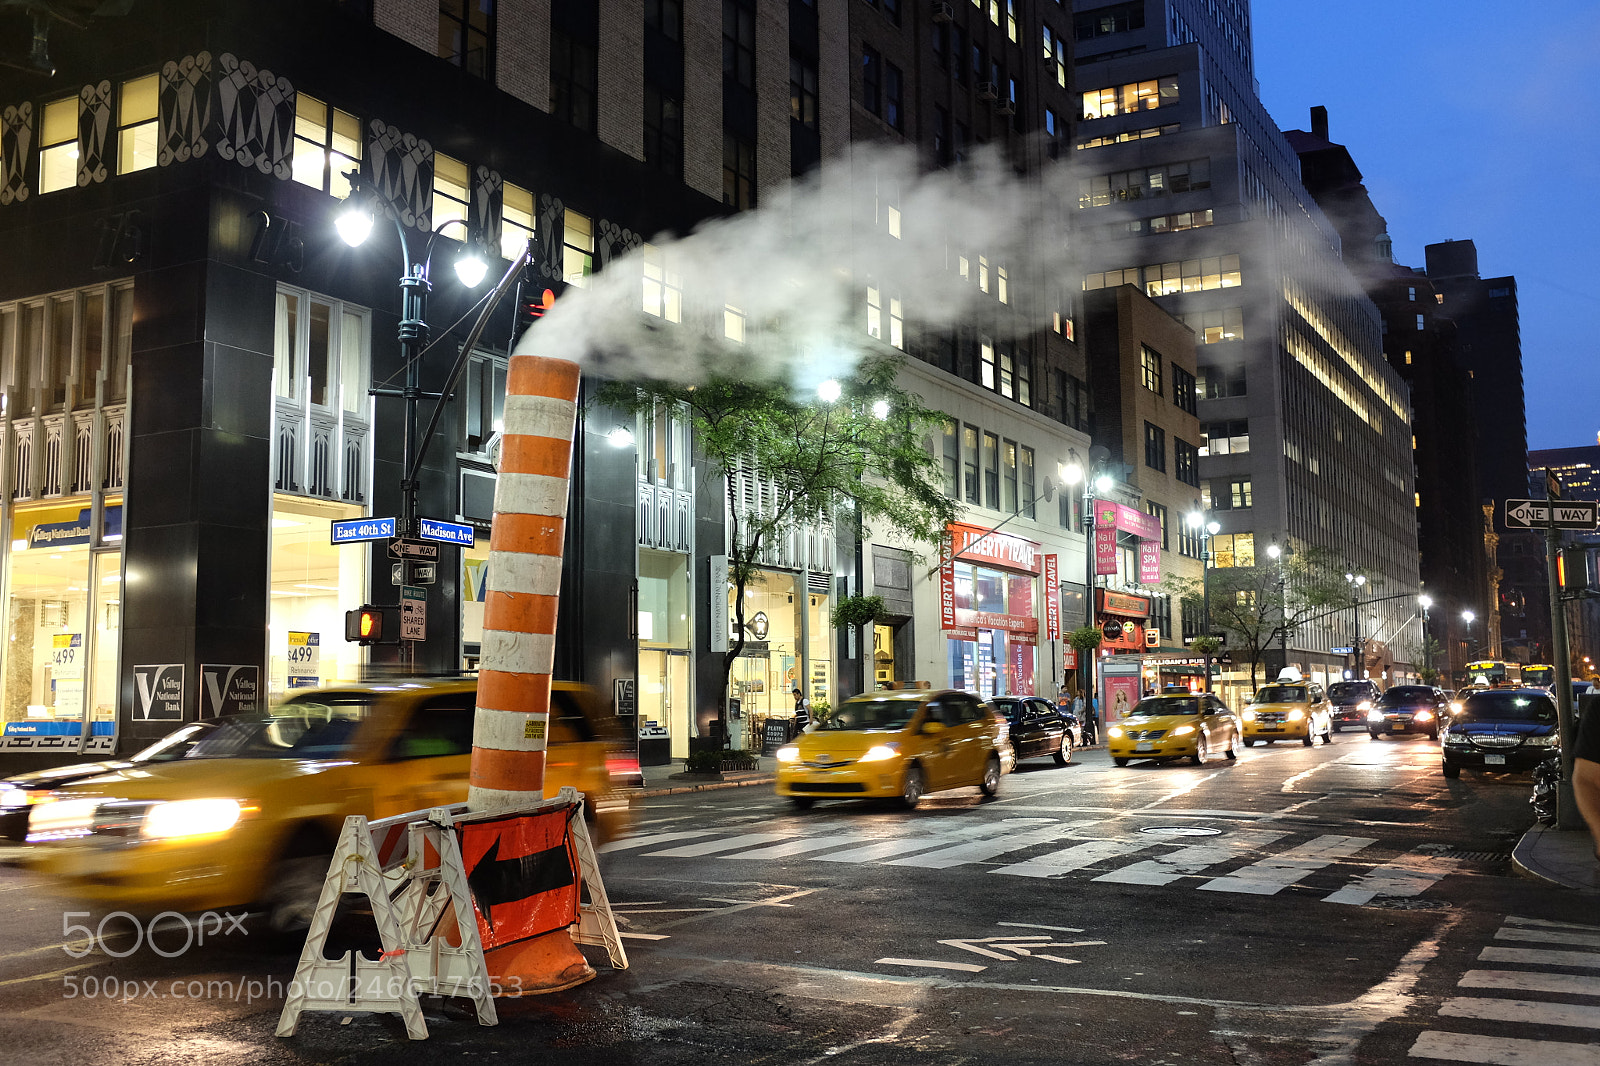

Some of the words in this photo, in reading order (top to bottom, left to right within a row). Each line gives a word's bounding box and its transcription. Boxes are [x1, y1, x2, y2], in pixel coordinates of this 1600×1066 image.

[1516, 509, 1544, 520] ONE
[1560, 510, 1588, 520] WAY
[336, 526, 356, 538] East
[358, 524, 378, 535] 40th
[380, 523, 391, 534] St
[422, 523, 456, 539] Madison
[458, 532, 472, 542] Ave
[1098, 531, 1115, 542] Nail
[394, 544, 410, 553] ONE
[419, 546, 435, 556] WAY
[942, 534, 952, 574] TRAVEL
[963, 531, 1006, 558] LIBERTY
[1004, 540, 1035, 566] TRAVEL
[1099, 544, 1113, 553] SPA
[1142, 544, 1158, 553] Nail
[1144, 554, 1156, 564] SPA
[418, 568, 432, 577] WAY
[1047, 557, 1056, 592] TRAVEL
[944, 579, 954, 626] LIBERTY
[404, 616, 424, 626] SHARED
[988, 616, 1008, 626] Vacation
[1008, 618, 1024, 630] Experts
[406, 626, 420, 636] LANE
[53, 648, 74, 666] $499
[288, 646, 312, 664] $499
[1142, 658, 1188, 666] MULLIGAN'S
[162, 677, 180, 690] Valley
[235, 677, 256, 690] Valley
[156, 692, 180, 700] National
[229, 692, 256, 700] National
[165, 702, 180, 711] Bank
[238, 702, 255, 710] Bank
